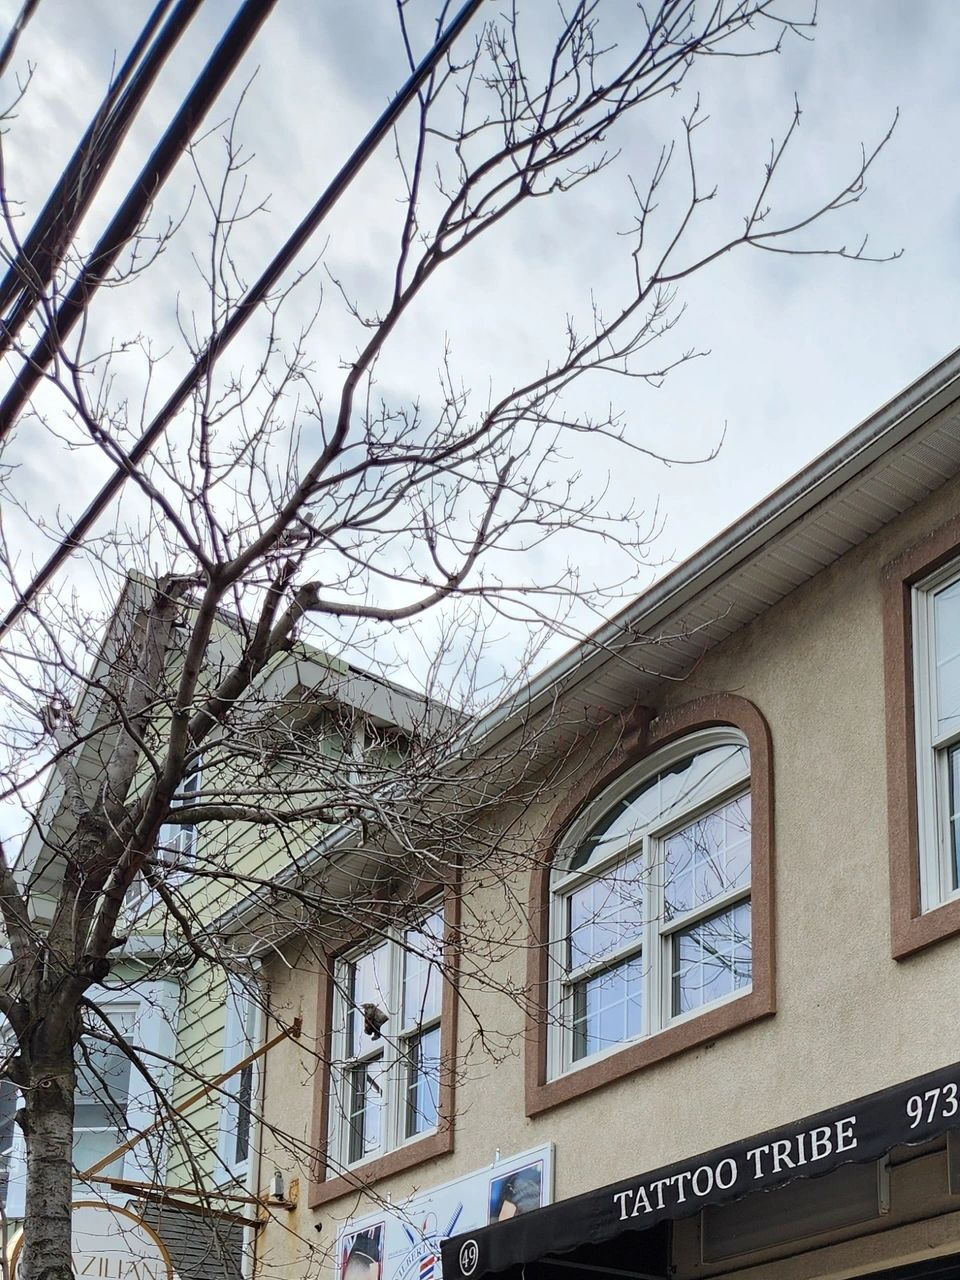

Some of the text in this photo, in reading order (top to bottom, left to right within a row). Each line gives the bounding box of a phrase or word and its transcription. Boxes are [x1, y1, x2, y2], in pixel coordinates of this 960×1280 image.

[613, 1157, 738, 1222] TATTOO
[746, 1115, 859, 1181] TRIBE
[461, 1246, 476, 1268] 49
